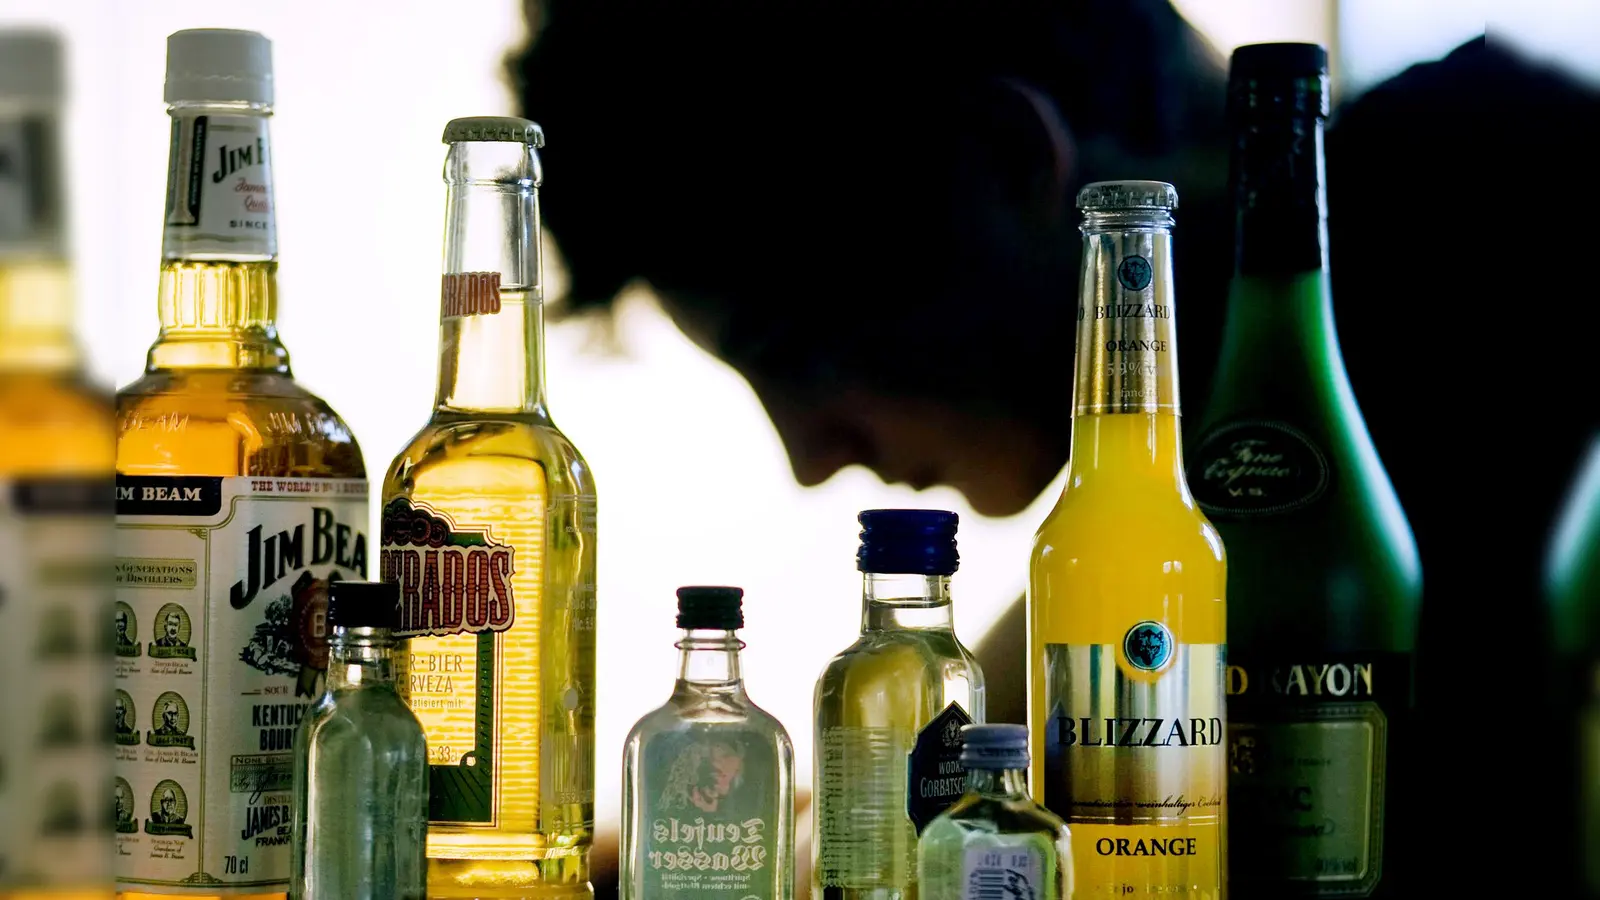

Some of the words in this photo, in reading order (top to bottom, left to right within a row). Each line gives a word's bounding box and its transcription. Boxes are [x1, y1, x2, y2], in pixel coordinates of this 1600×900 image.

[213, 144, 252, 183] JIM
[1094, 303, 1170, 320] BLIZZARD
[1105, 340, 1167, 352] ORANGE
[142, 487, 202, 501] BEAM
[251, 480, 273, 492] THE
[230, 524, 305, 610] JIM
[428, 654, 462, 672] BIER
[264, 686, 289, 695] SOUR
[260, 728, 297, 751] BOUR
[1057, 717, 1223, 747] BLIZZARD
[242, 805, 281, 840] JAMES
[1096, 838, 1196, 857] ORANGE
[224, 856, 237, 874] 70
